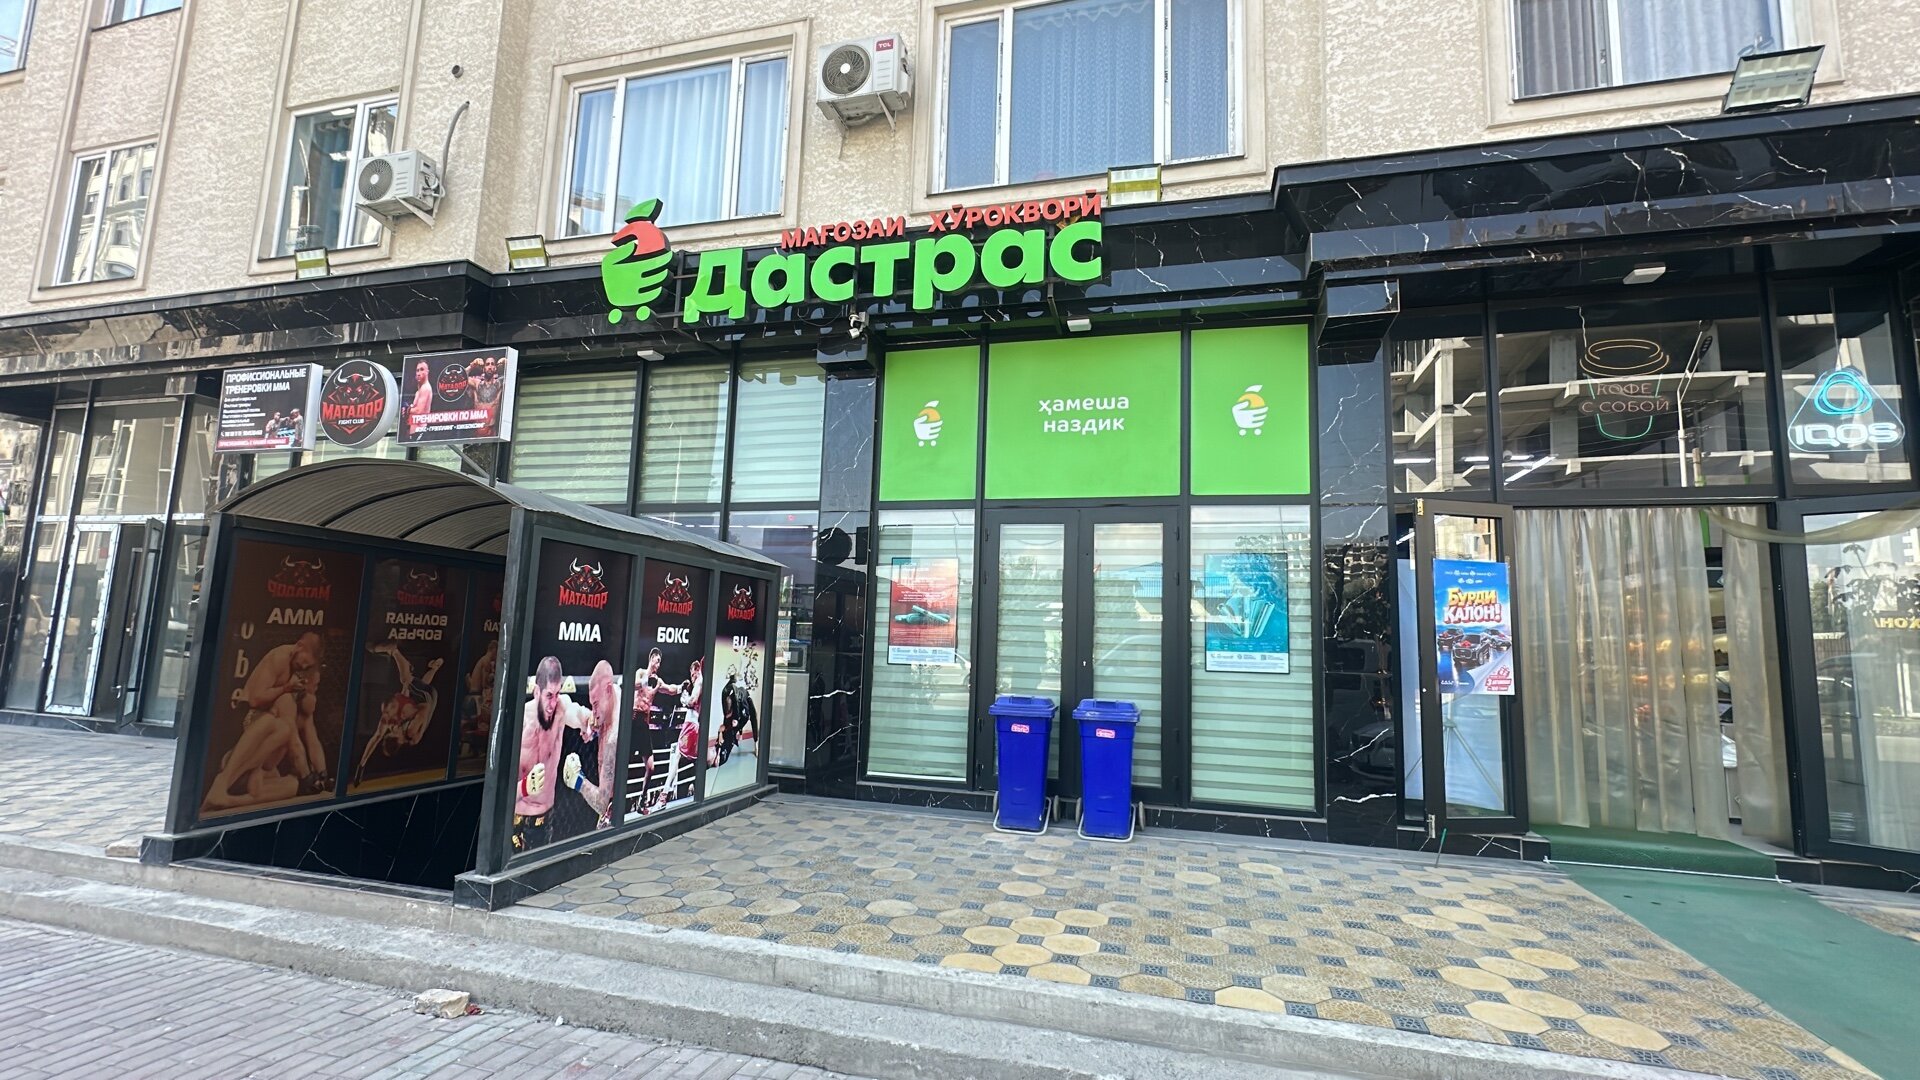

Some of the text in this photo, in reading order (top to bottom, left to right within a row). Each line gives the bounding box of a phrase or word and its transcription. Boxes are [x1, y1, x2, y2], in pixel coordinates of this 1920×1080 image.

[272, 380, 290, 392] ММА
[1597, 382, 1653, 396] КОФЕ
[322, 396, 385, 420] МАТАДОР
[1038, 396, 1129, 416] ҳамеша
[1599, 398, 1669, 413] СОБОЙ
[411, 409, 489, 424] ТРЕНИРОВКИ ПО ММА
[1043, 417, 1125, 436] наздик
[1795, 422, 1899, 448] IQOS
[559, 584, 608, 610] МАТАДОР
[656, 595, 693, 617] МАТАДОР
[1447, 587, 1498, 608] БУРДИ
[728, 604, 756, 621] МАТАДОР
[1443, 603, 1503, 624] КАЛОН!
[558, 621, 602, 643] ММА
[656, 626, 690, 644] БОКС
